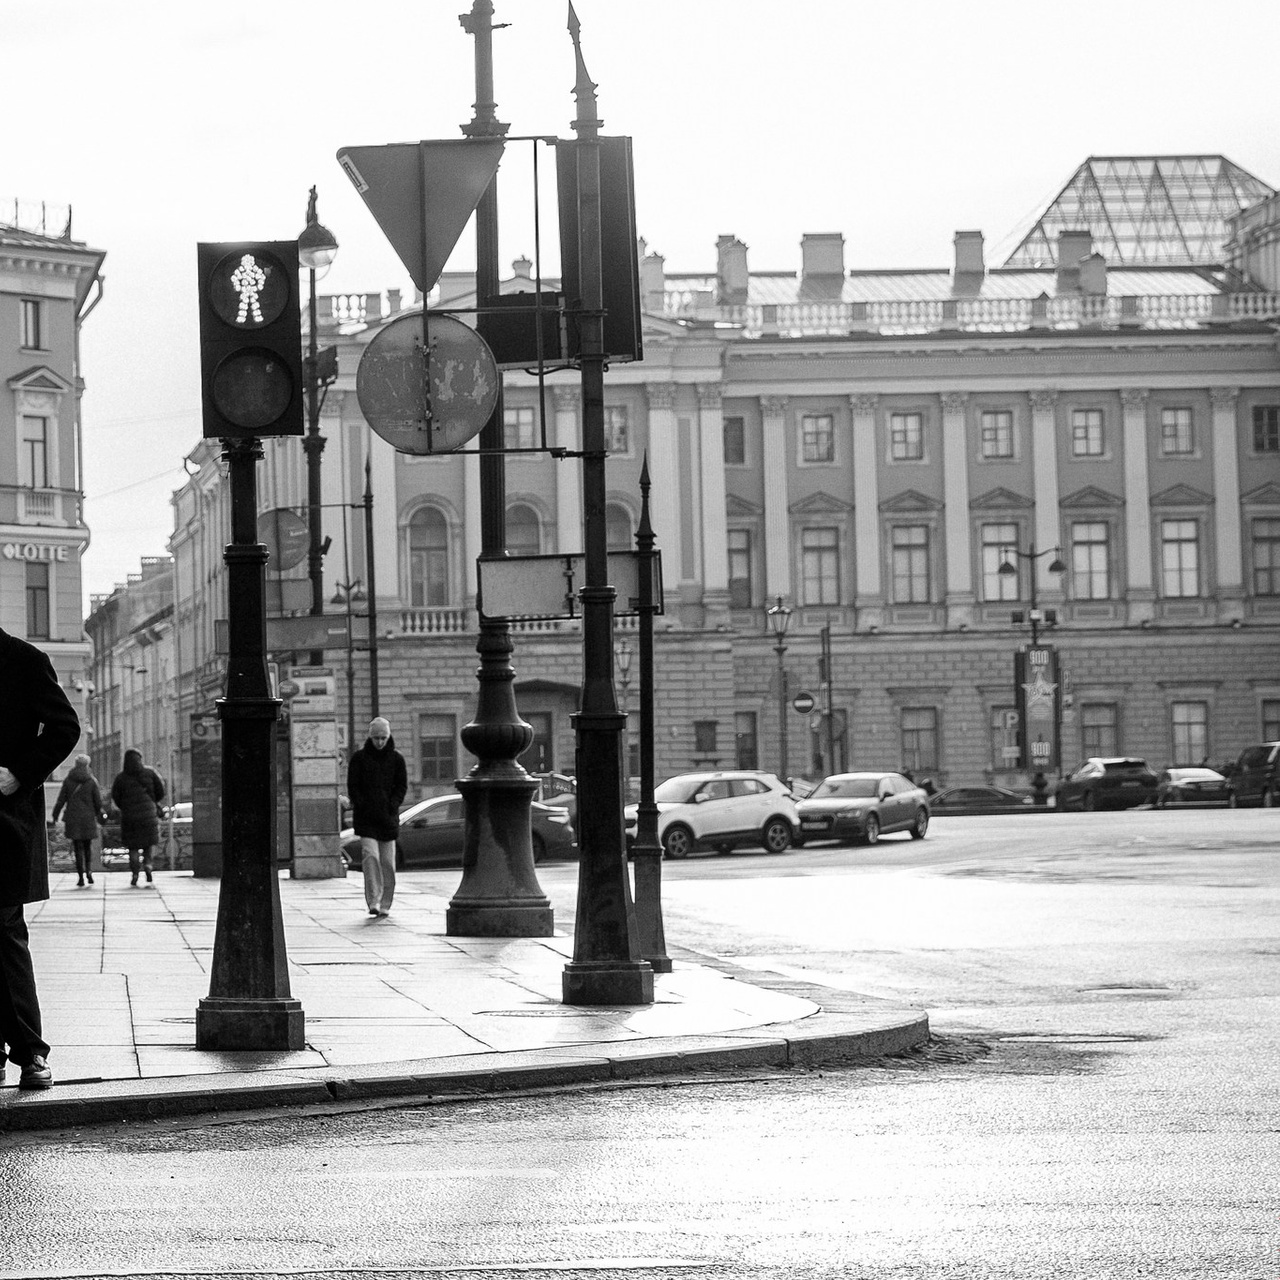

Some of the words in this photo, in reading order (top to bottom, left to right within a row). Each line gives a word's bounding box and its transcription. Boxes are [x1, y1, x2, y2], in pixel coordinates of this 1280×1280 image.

[15, 543, 69, 561] LOTTE
[1029, 650, 1049, 665] 900
[1031, 742, 1051, 757] 900
